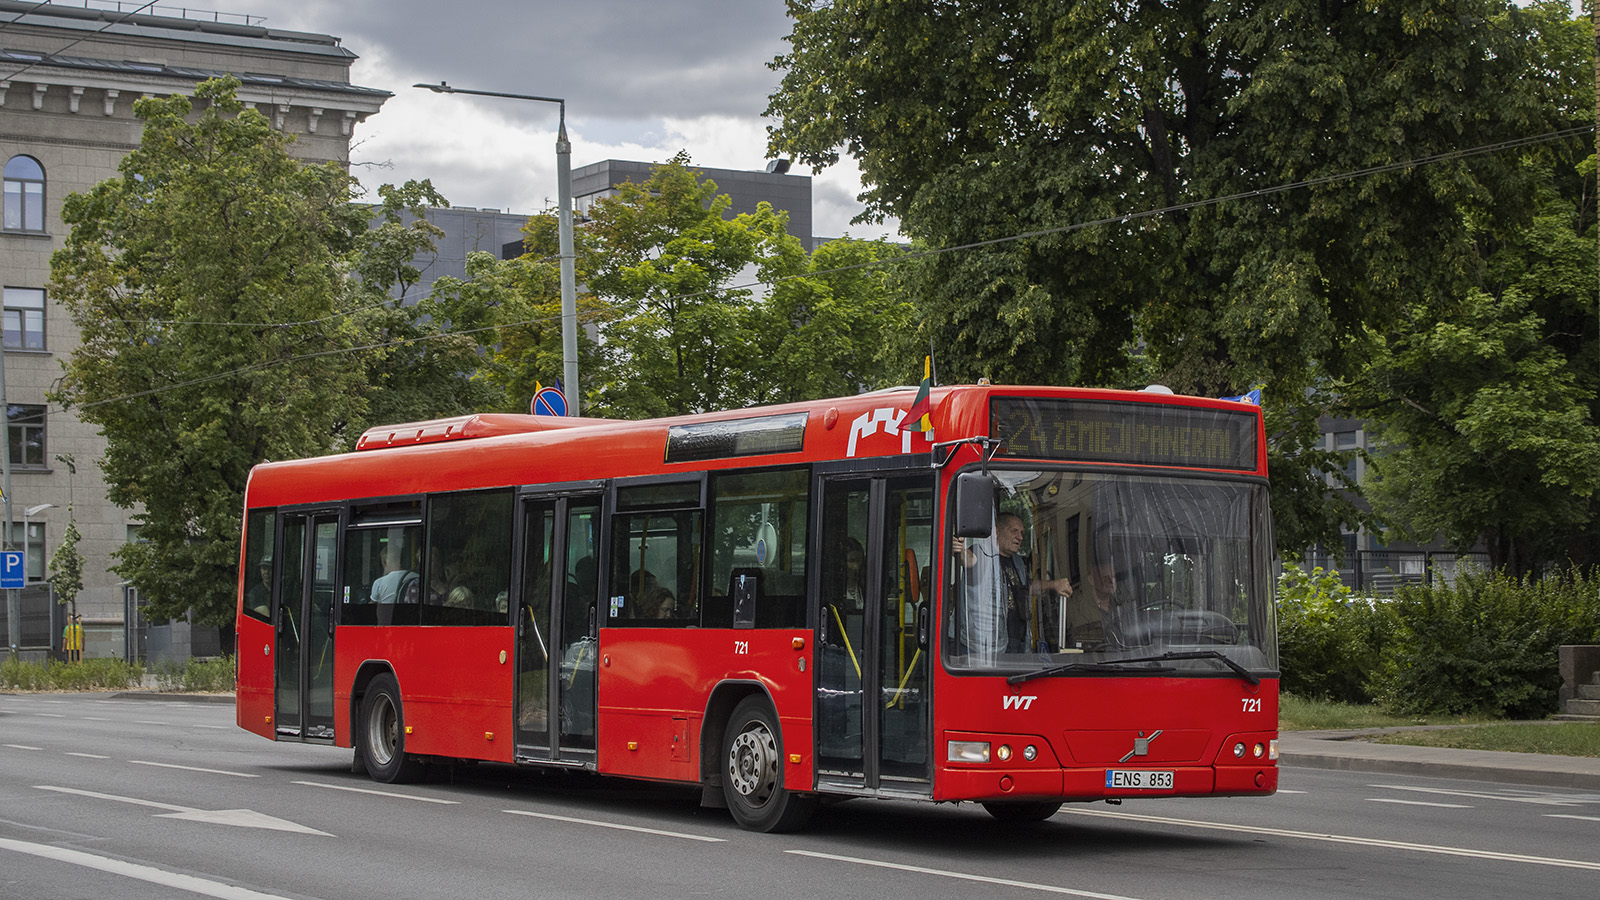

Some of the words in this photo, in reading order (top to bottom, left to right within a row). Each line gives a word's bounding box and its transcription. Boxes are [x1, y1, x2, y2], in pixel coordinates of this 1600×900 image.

[1008, 410, 1047, 452] 24
[1136, 423, 1231, 459] PANERIAI
[6, 553, 20, 573] P
[734, 641, 749, 655] 721
[1002, 695, 1038, 710] VVT
[1241, 698, 1261, 712] 721
[1114, 772, 1141, 786] ENS
[1149, 773, 1172, 787] 853
